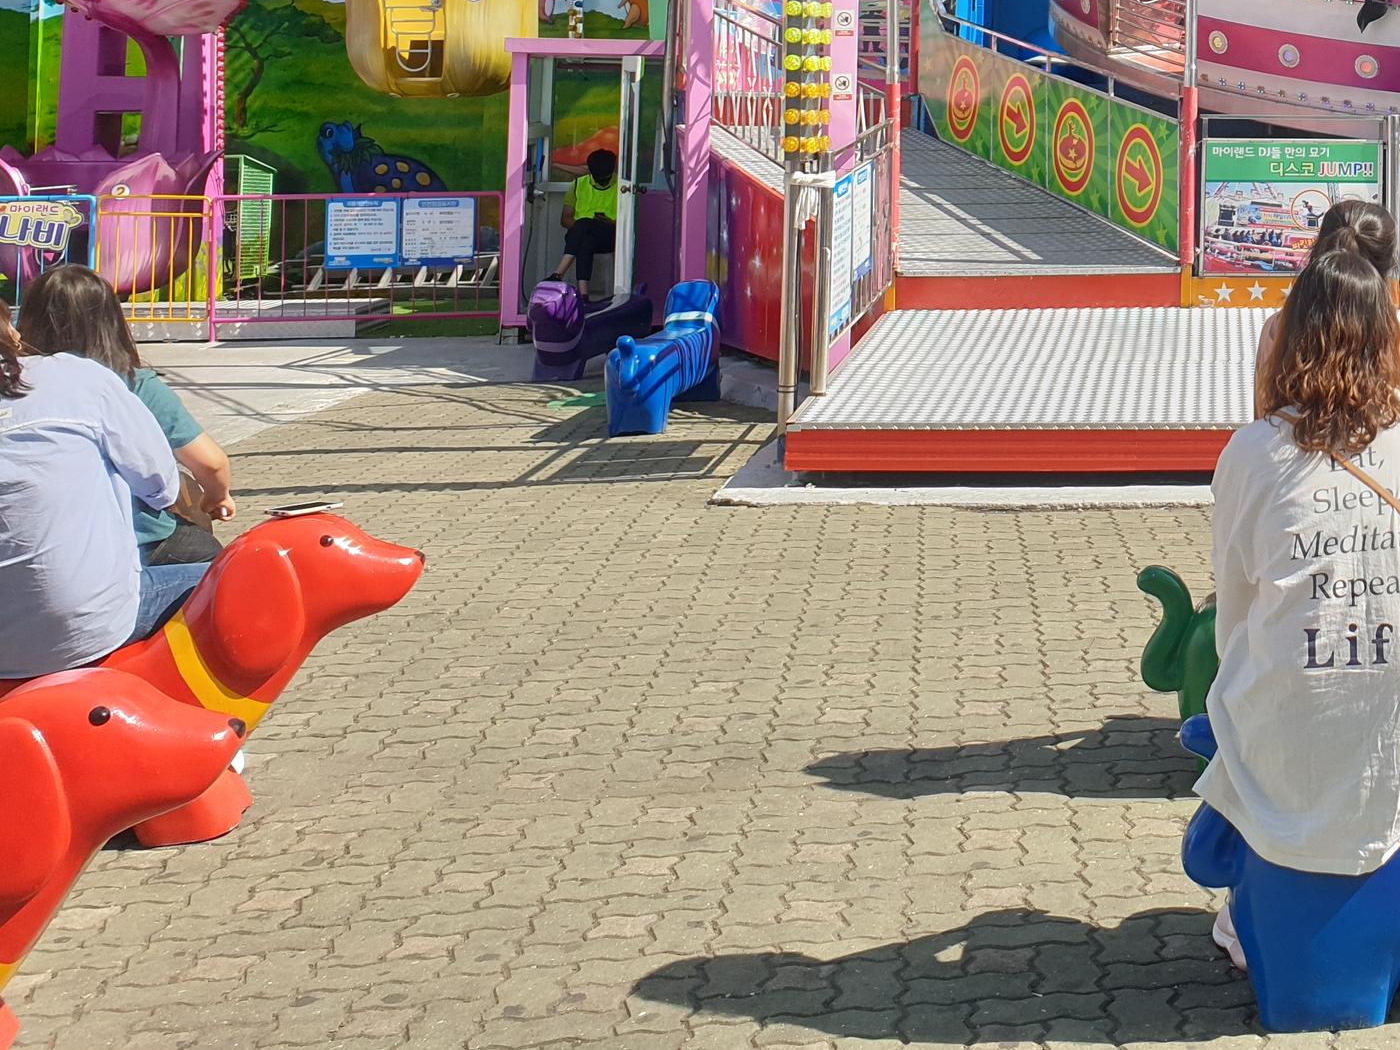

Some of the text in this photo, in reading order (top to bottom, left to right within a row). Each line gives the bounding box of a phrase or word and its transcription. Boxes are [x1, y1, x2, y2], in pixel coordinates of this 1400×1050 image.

[1285, 146, 1306, 158] 만의
[1309, 147, 1330, 158] 묘기
[1270, 161, 1374, 178] 디스코 JUMP!!
[10, 204, 59, 217] 마이랜드
[0, 215, 65, 246] 나비
